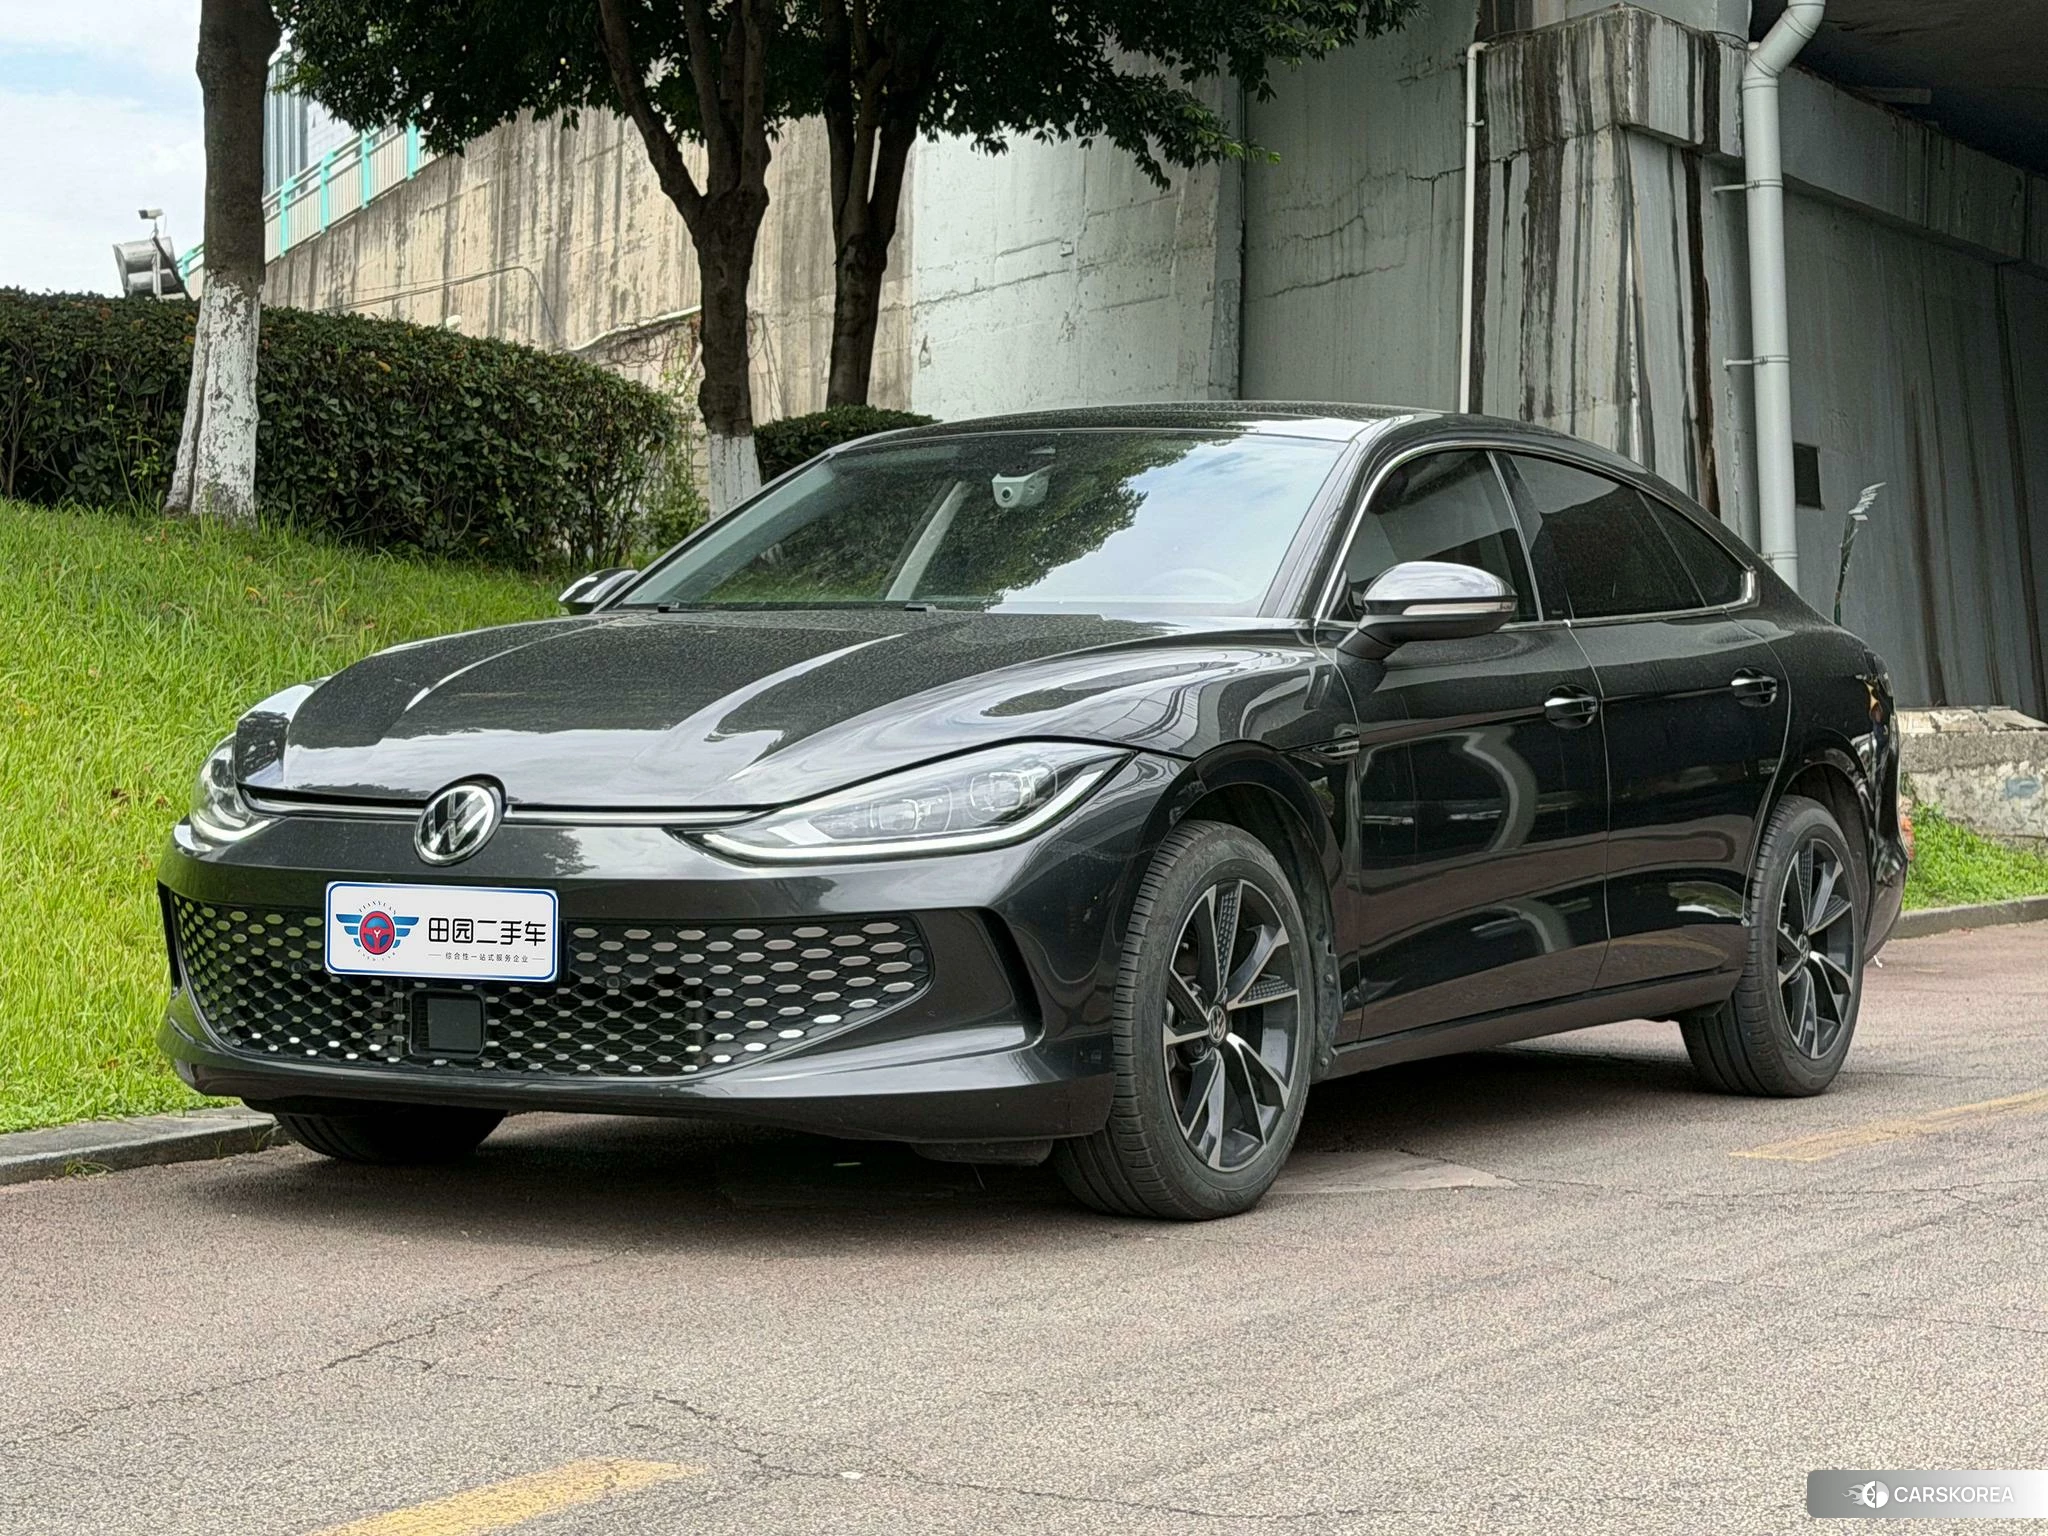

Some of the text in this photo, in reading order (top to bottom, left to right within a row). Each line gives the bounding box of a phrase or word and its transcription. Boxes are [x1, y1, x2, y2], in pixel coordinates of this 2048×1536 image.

[423, 788, 491, 856] VW
[429, 917, 547, 947] 田园二手车
[445, 951, 529, 963] 综合性一站式服务企业
